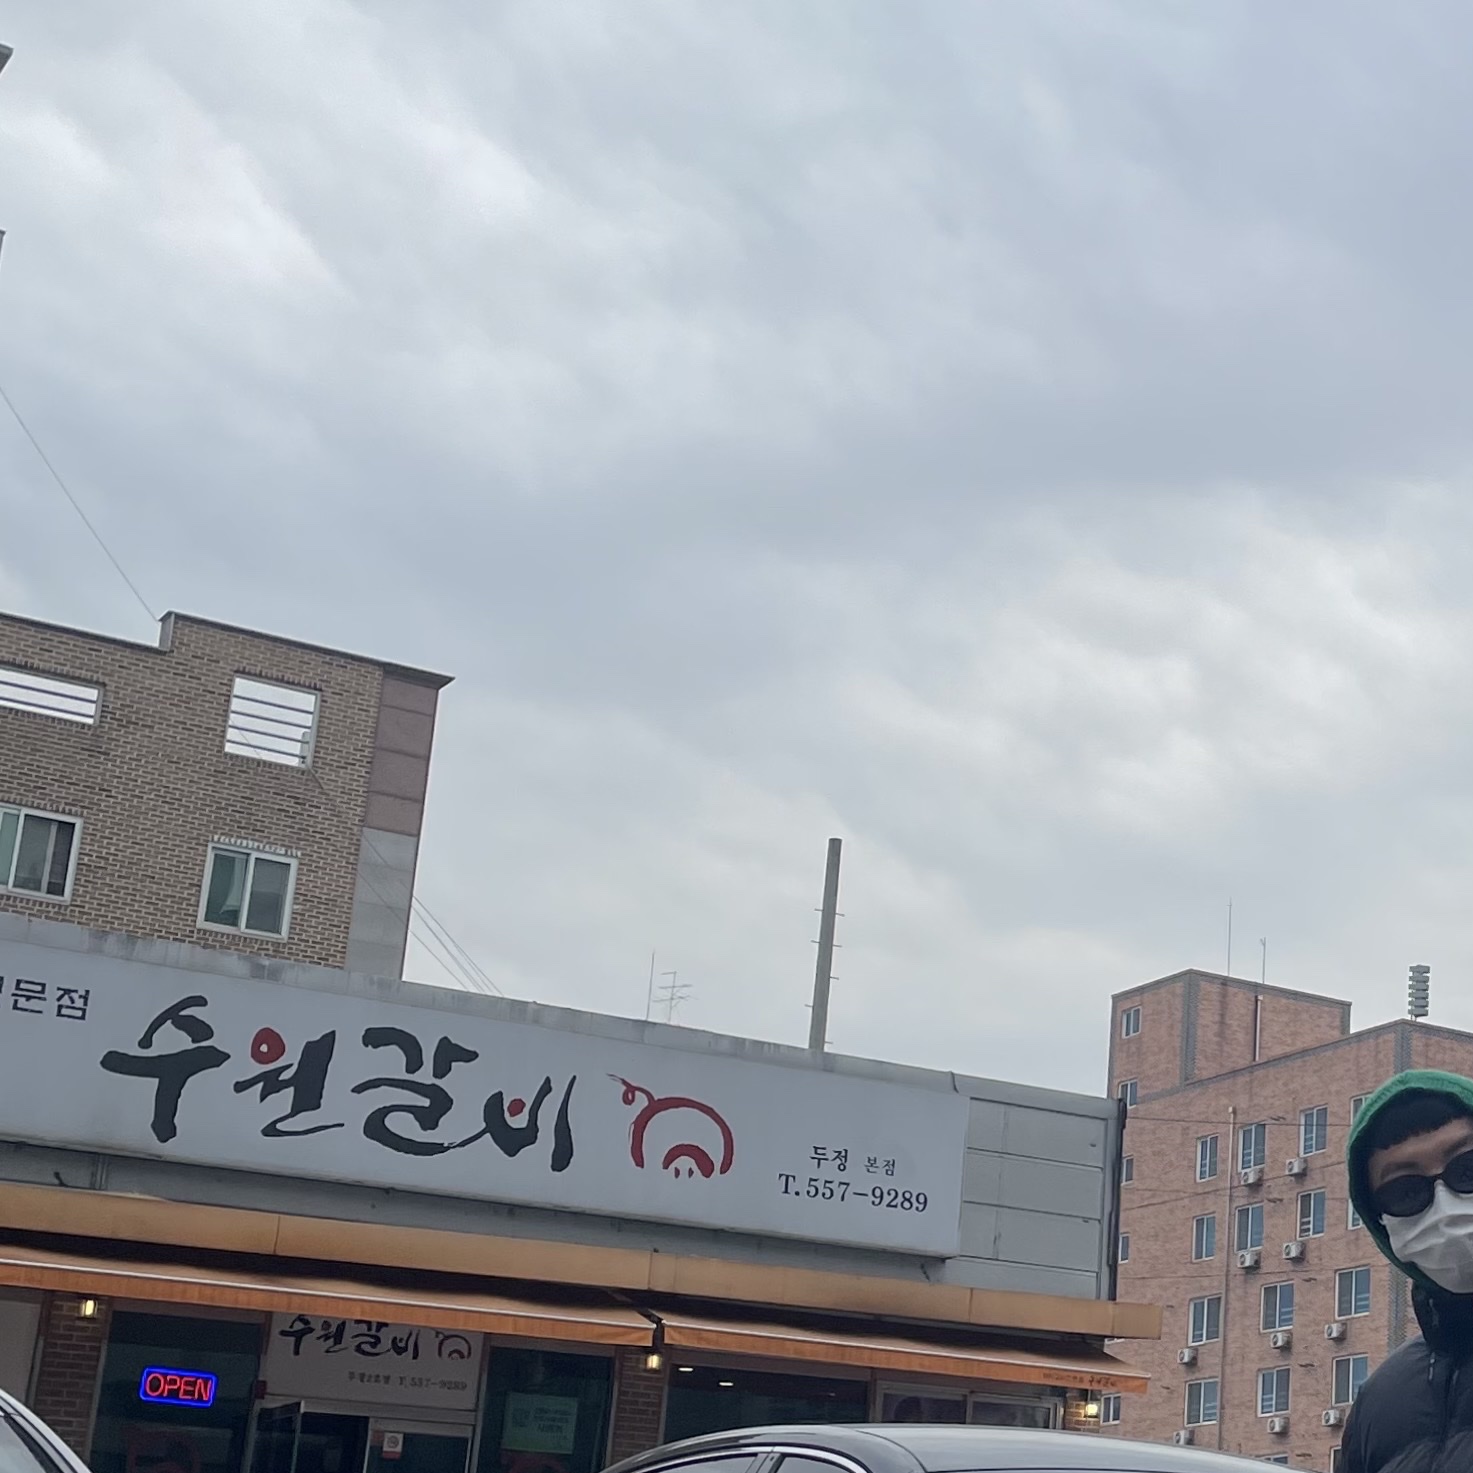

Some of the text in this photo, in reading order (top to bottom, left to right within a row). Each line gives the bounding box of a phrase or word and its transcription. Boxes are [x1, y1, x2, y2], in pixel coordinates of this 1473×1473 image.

[0, 976, 90, 1021] 문점
[100, 995, 577, 1173] 수원갈비
[809, 1145, 896, 1177] 두정 본점
[145, 1373, 212, 1401] OPEN
